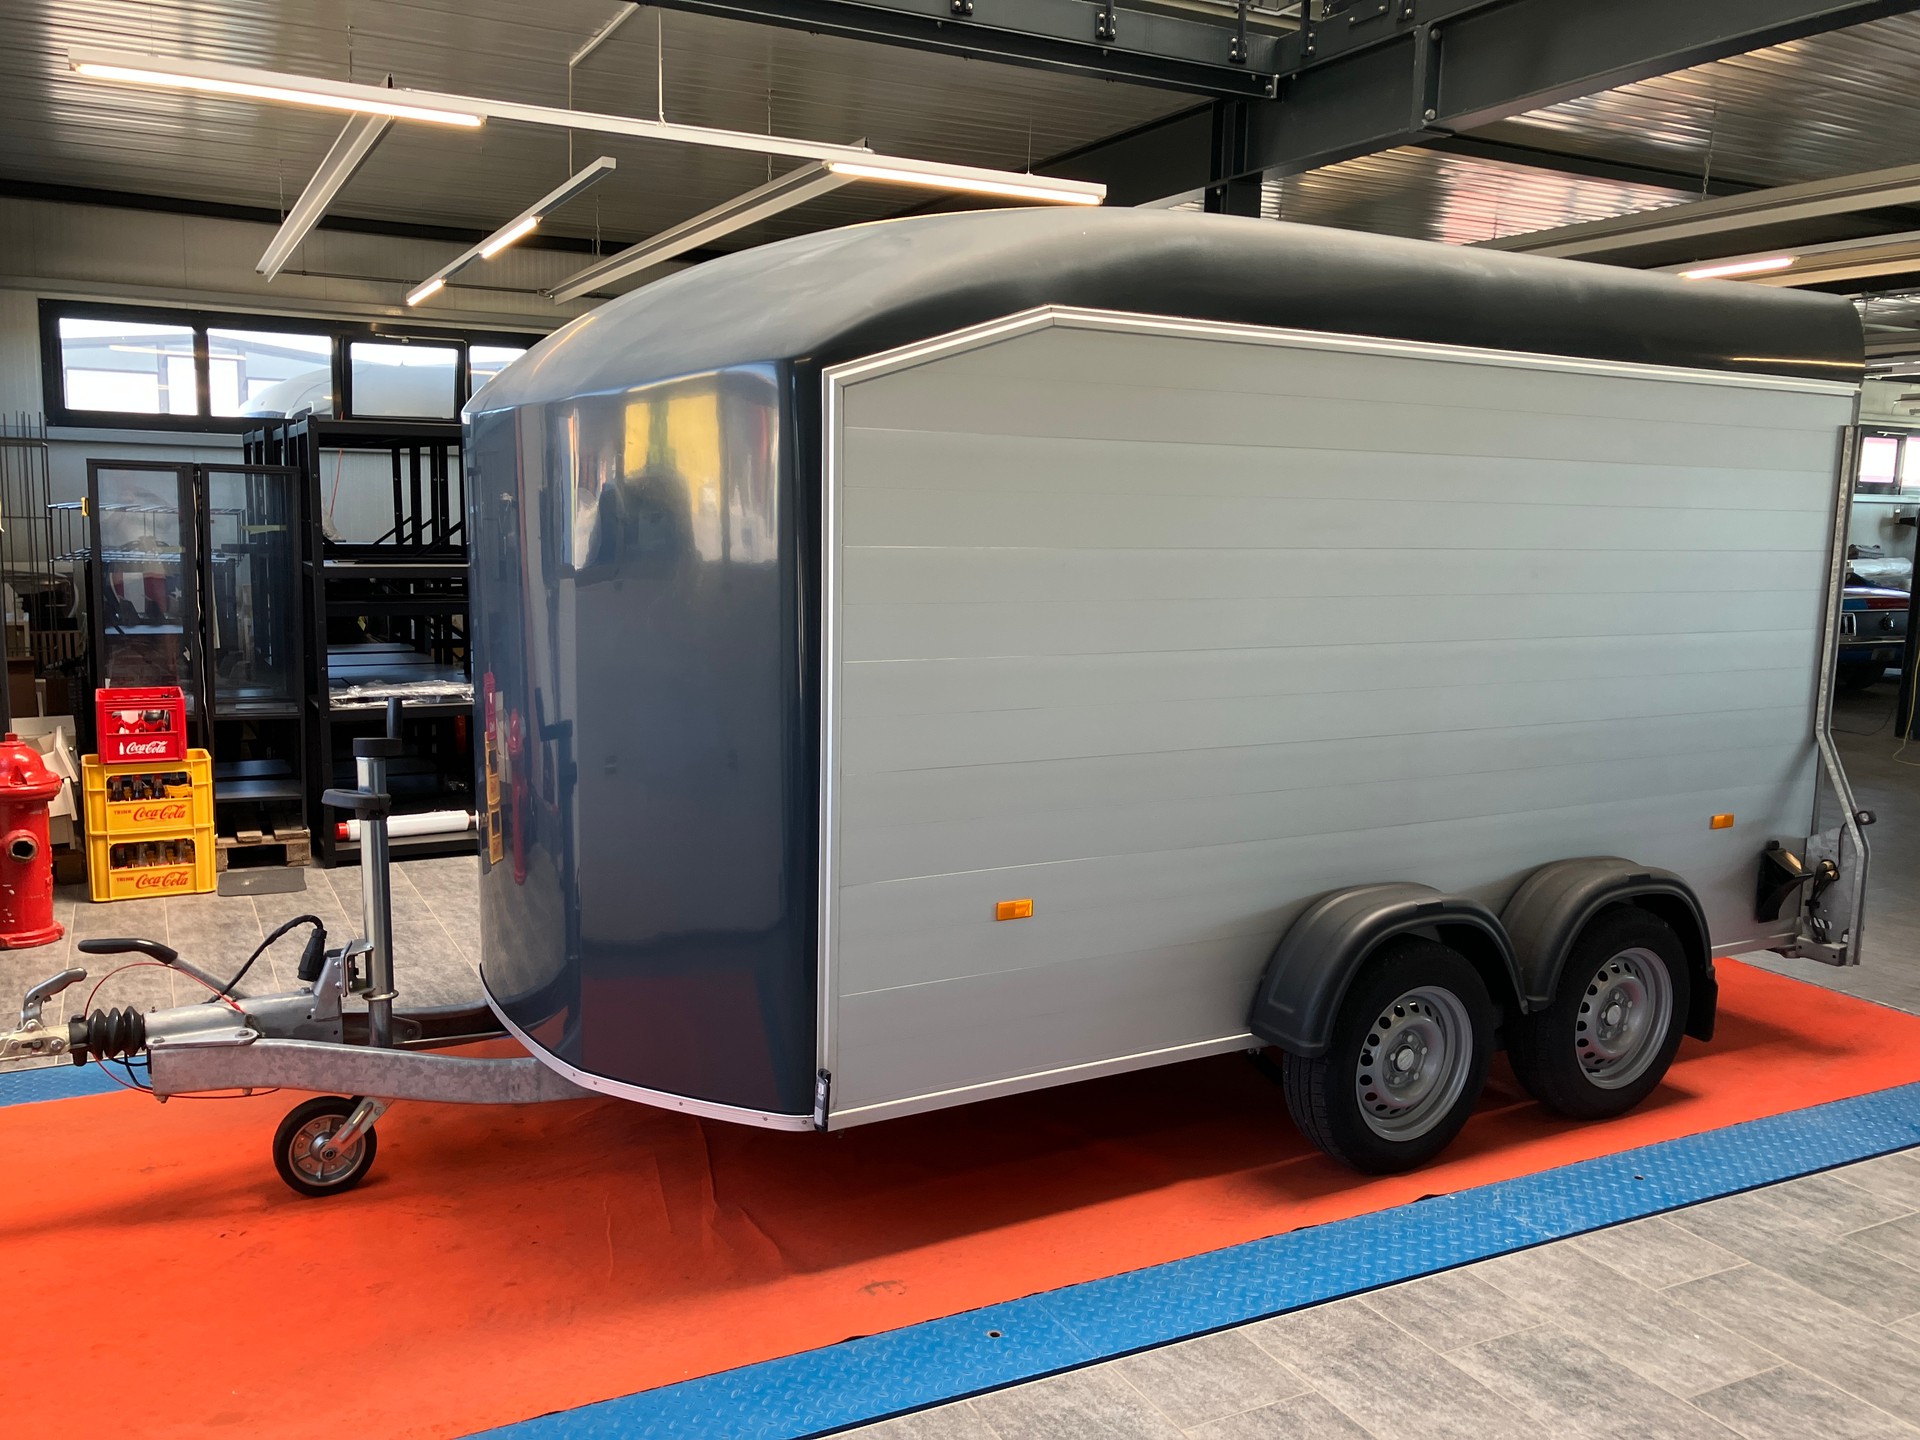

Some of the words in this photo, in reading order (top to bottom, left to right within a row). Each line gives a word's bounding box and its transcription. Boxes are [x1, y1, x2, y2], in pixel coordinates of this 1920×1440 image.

[126, 741, 168, 755] Coca-Cola
[133, 804, 187, 822] Coca-Cola
[136, 871, 190, 890] Coca-Cola
